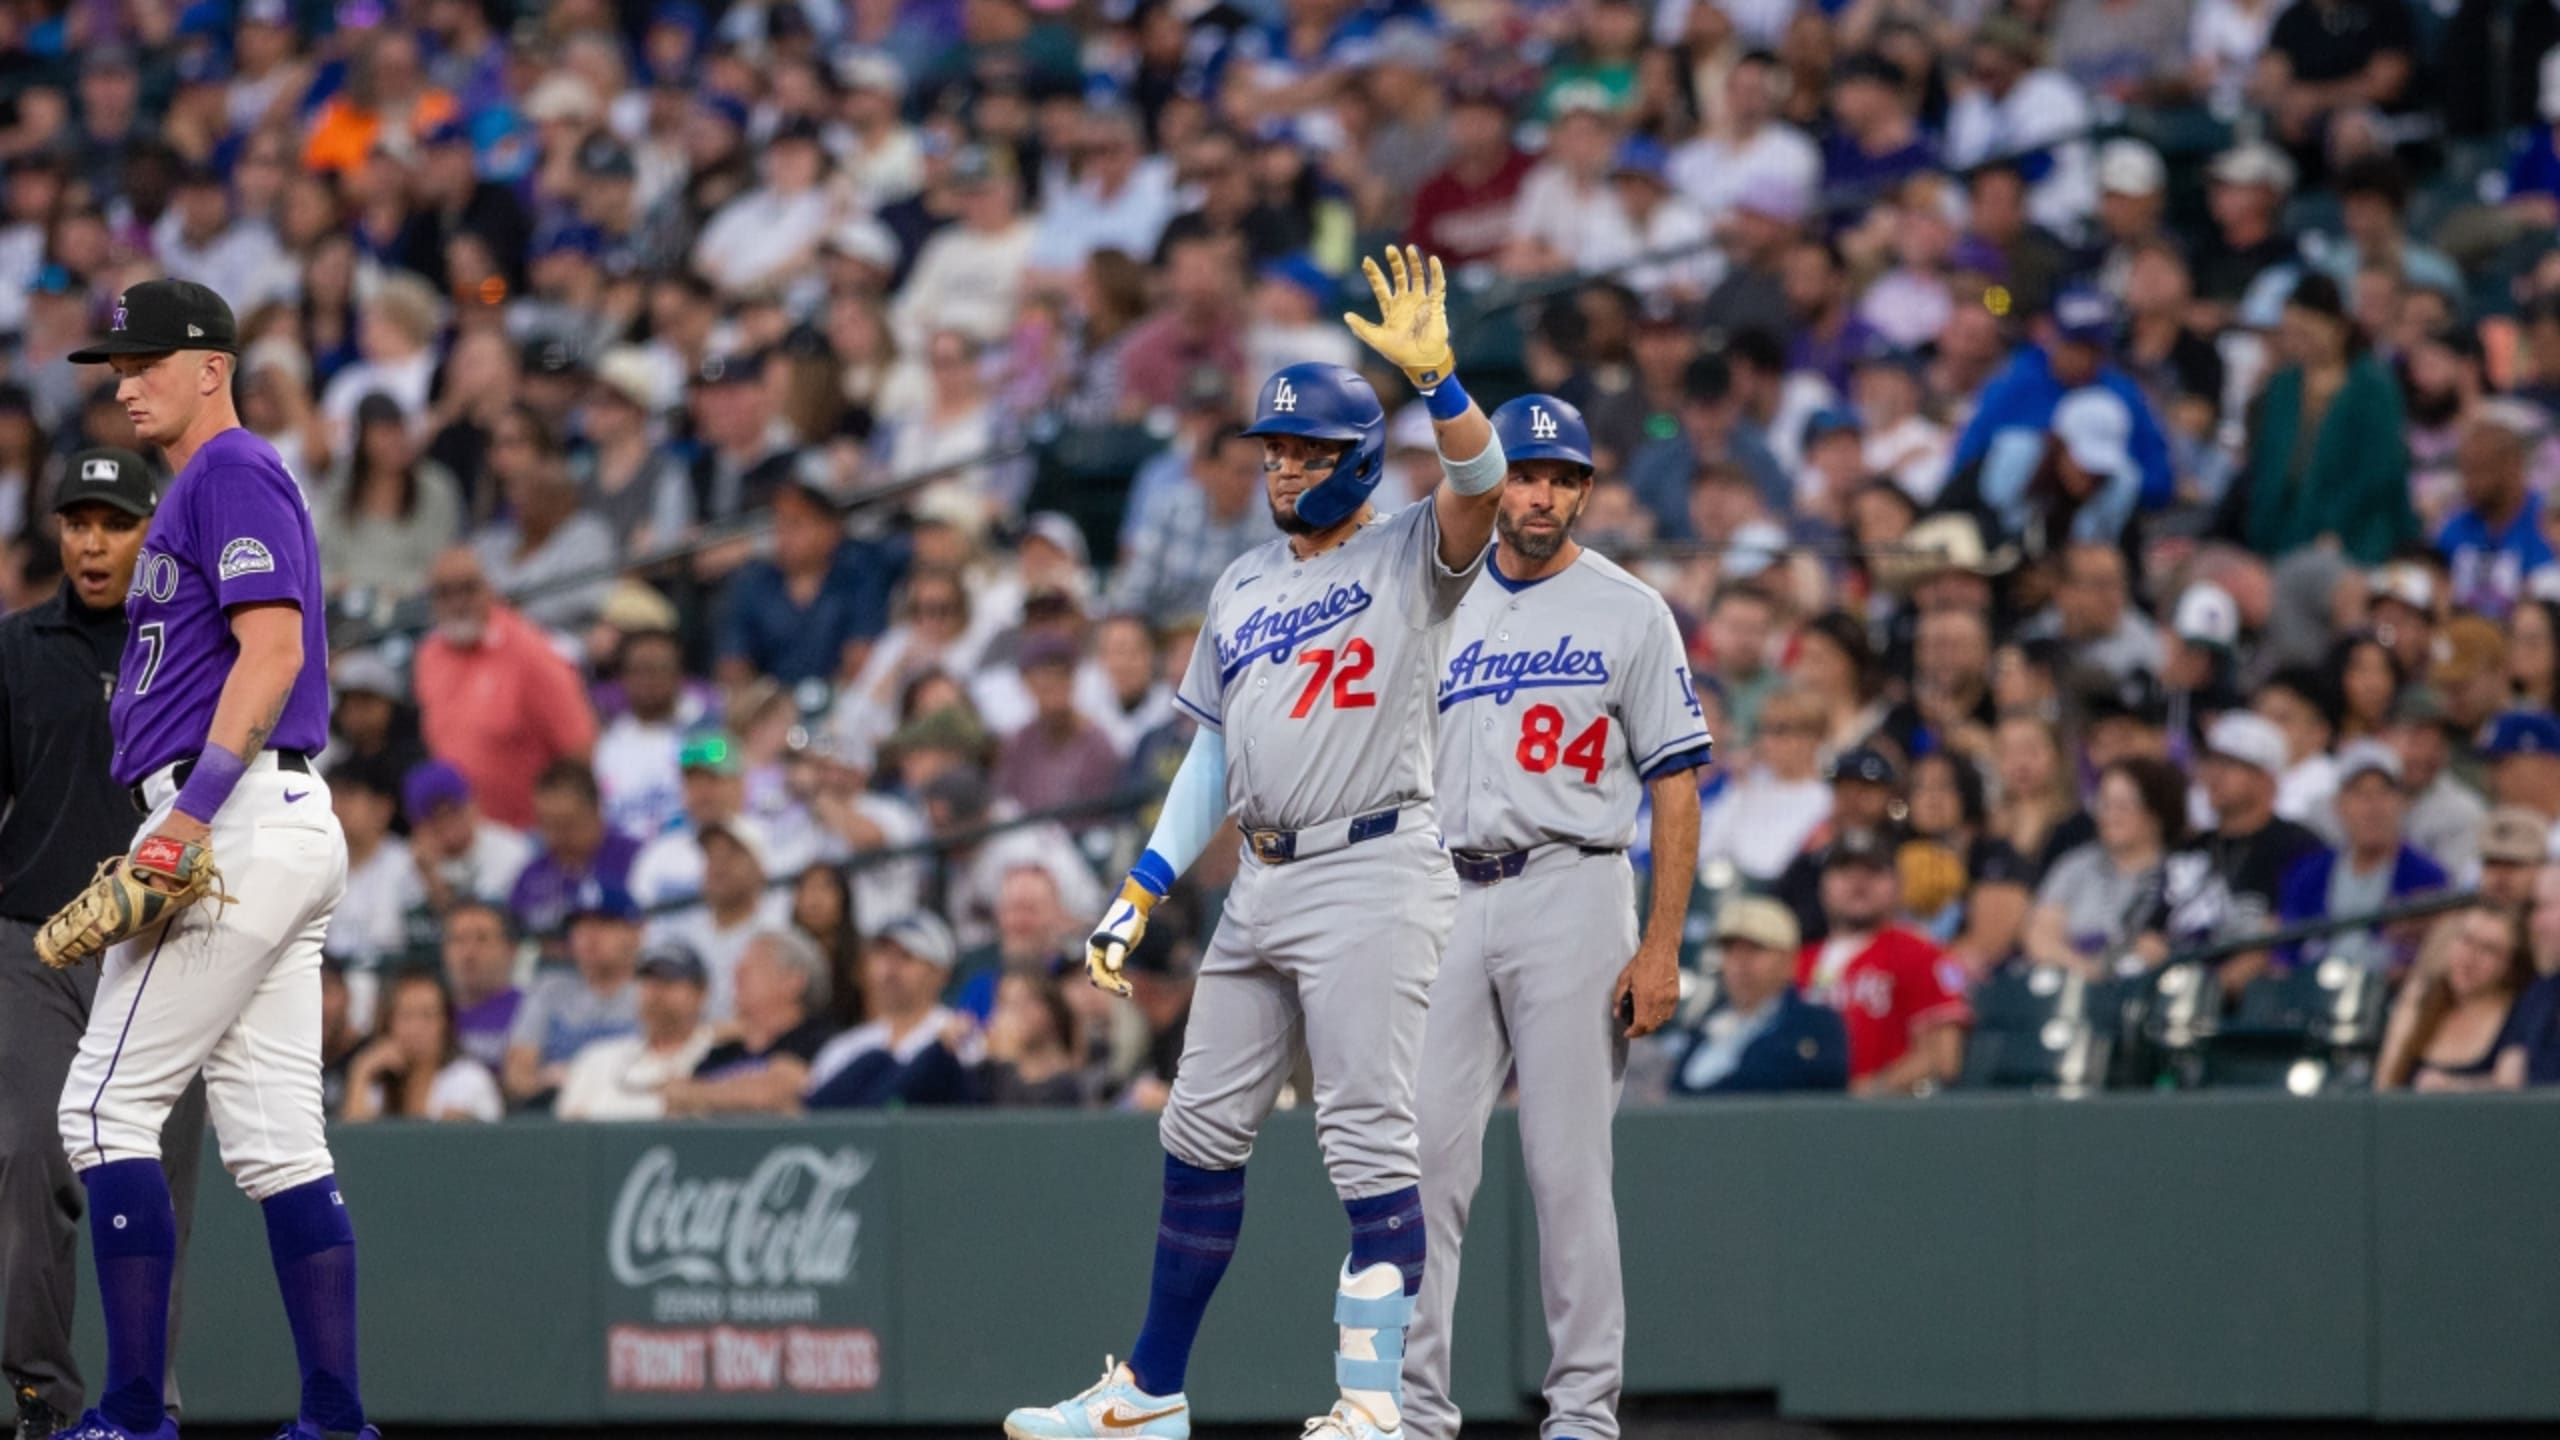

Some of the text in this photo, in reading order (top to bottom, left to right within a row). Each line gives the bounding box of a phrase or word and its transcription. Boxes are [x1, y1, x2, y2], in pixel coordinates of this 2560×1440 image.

[1273, 377, 1298, 412] LA
[1530, 405, 1557, 439] LA
[135, 621, 165, 695] 7
[1230, 579, 1372, 665] Angeles
[1288, 637, 1377, 719] 72
[1445, 634, 1609, 706] Angeles
[1515, 702, 1609, 785] 84
